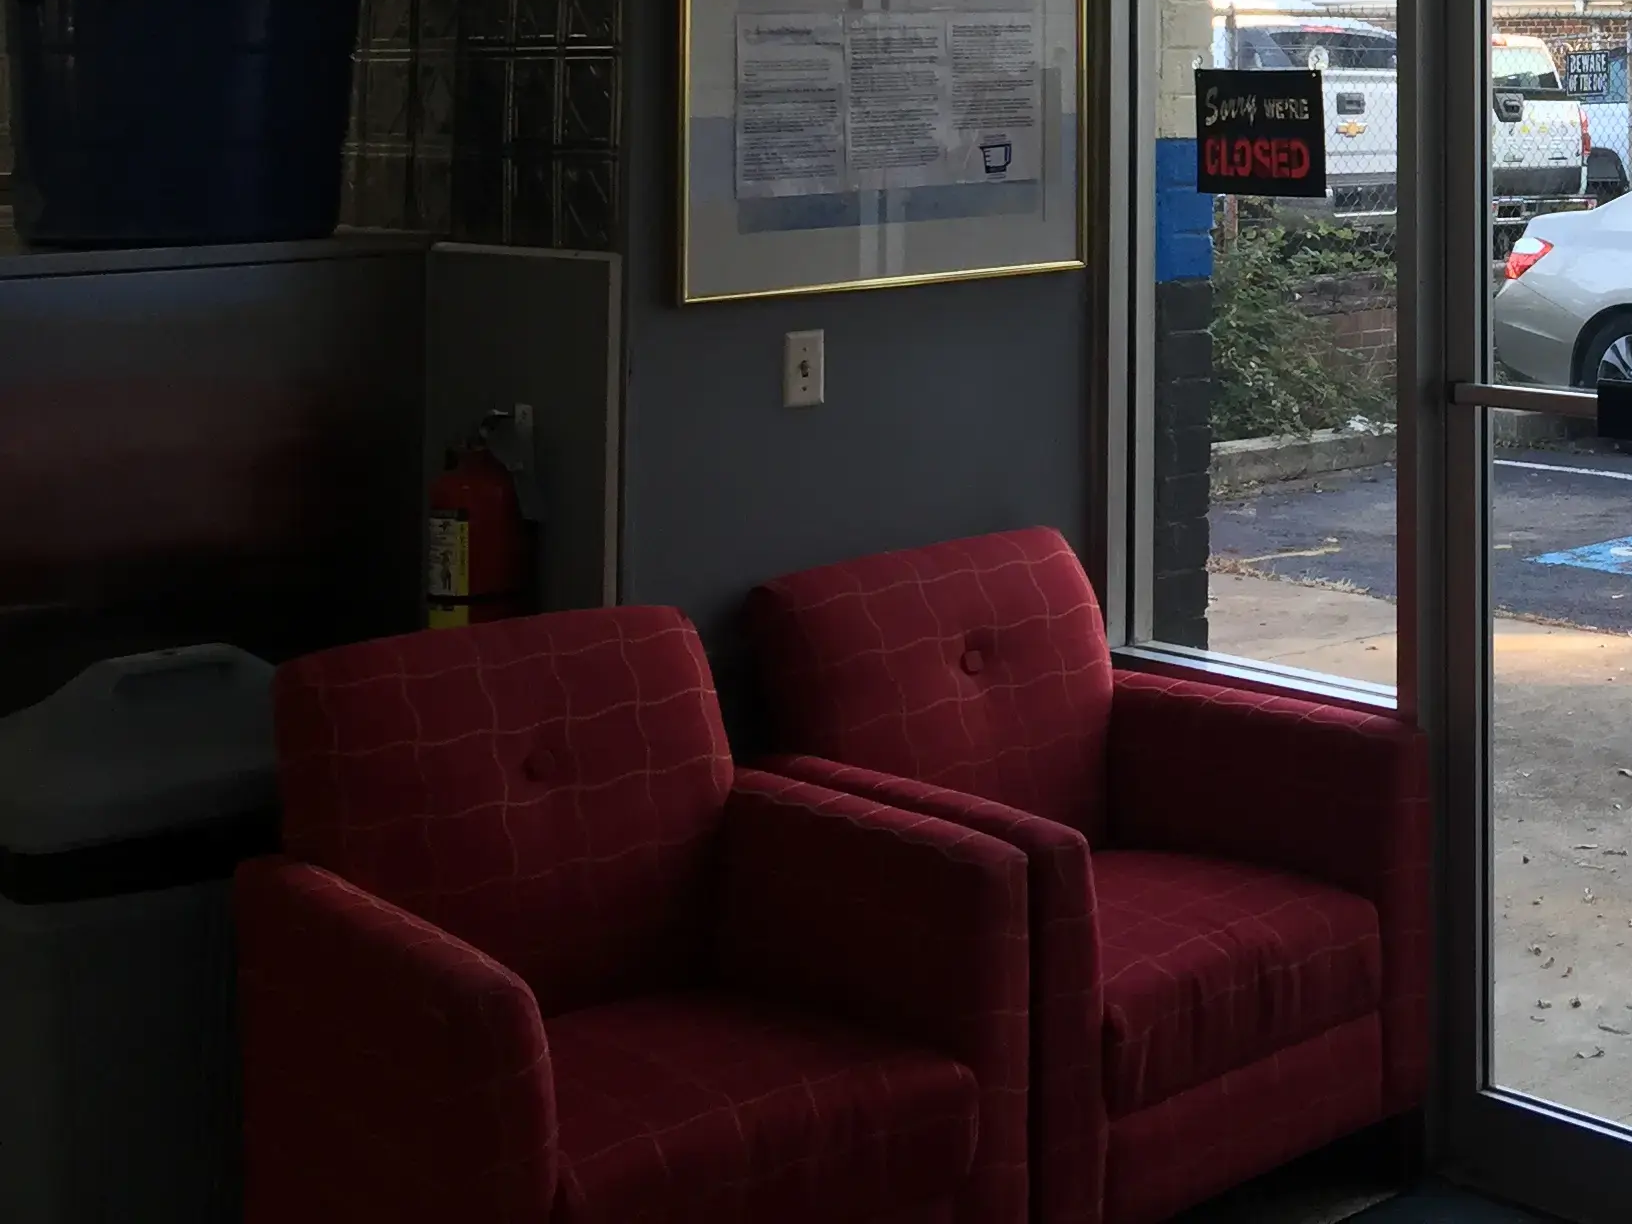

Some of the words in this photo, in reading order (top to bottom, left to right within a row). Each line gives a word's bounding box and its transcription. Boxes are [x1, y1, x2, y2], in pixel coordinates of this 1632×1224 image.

[1570, 54, 1607, 74] BEWARE
[1205, 87, 1257, 126] Sorry
[1264, 98, 1310, 119] WE'RE
[1205, 138, 1310, 178] CLOSED
